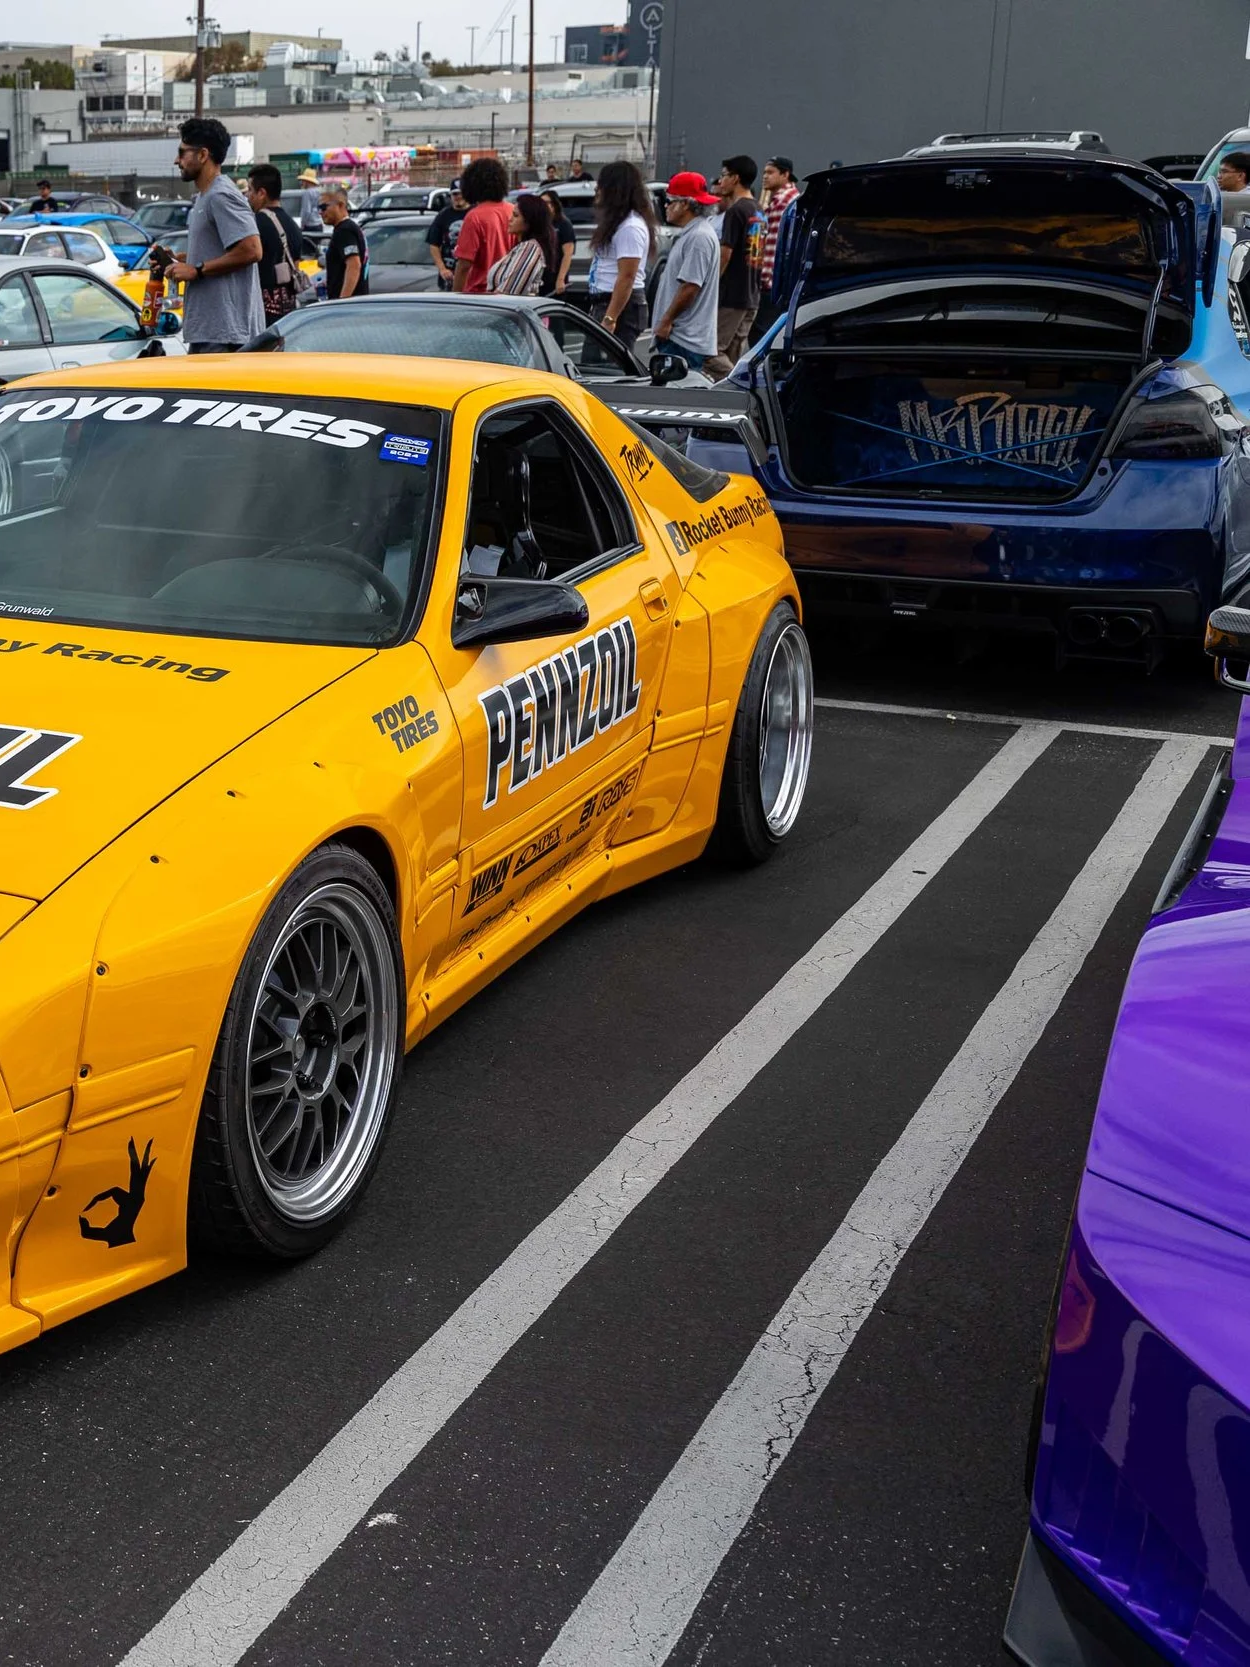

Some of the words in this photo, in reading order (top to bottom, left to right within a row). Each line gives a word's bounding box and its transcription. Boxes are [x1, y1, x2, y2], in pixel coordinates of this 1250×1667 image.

[163, 399, 386, 449] TIRES
[612, 406, 748, 422] unny
[390, 450, 419, 459] 2024
[679, 509, 726, 547] Rocket
[718, 500, 755, 530] Bunny
[41, 642, 232, 683] Racing
[371, 695, 420, 736] TOYO
[390, 710, 439, 754] TIRES
[478, 615, 642, 811] PENNZOIL
[596, 767, 639, 817] RAYS
[469, 852, 514, 903] WINN
